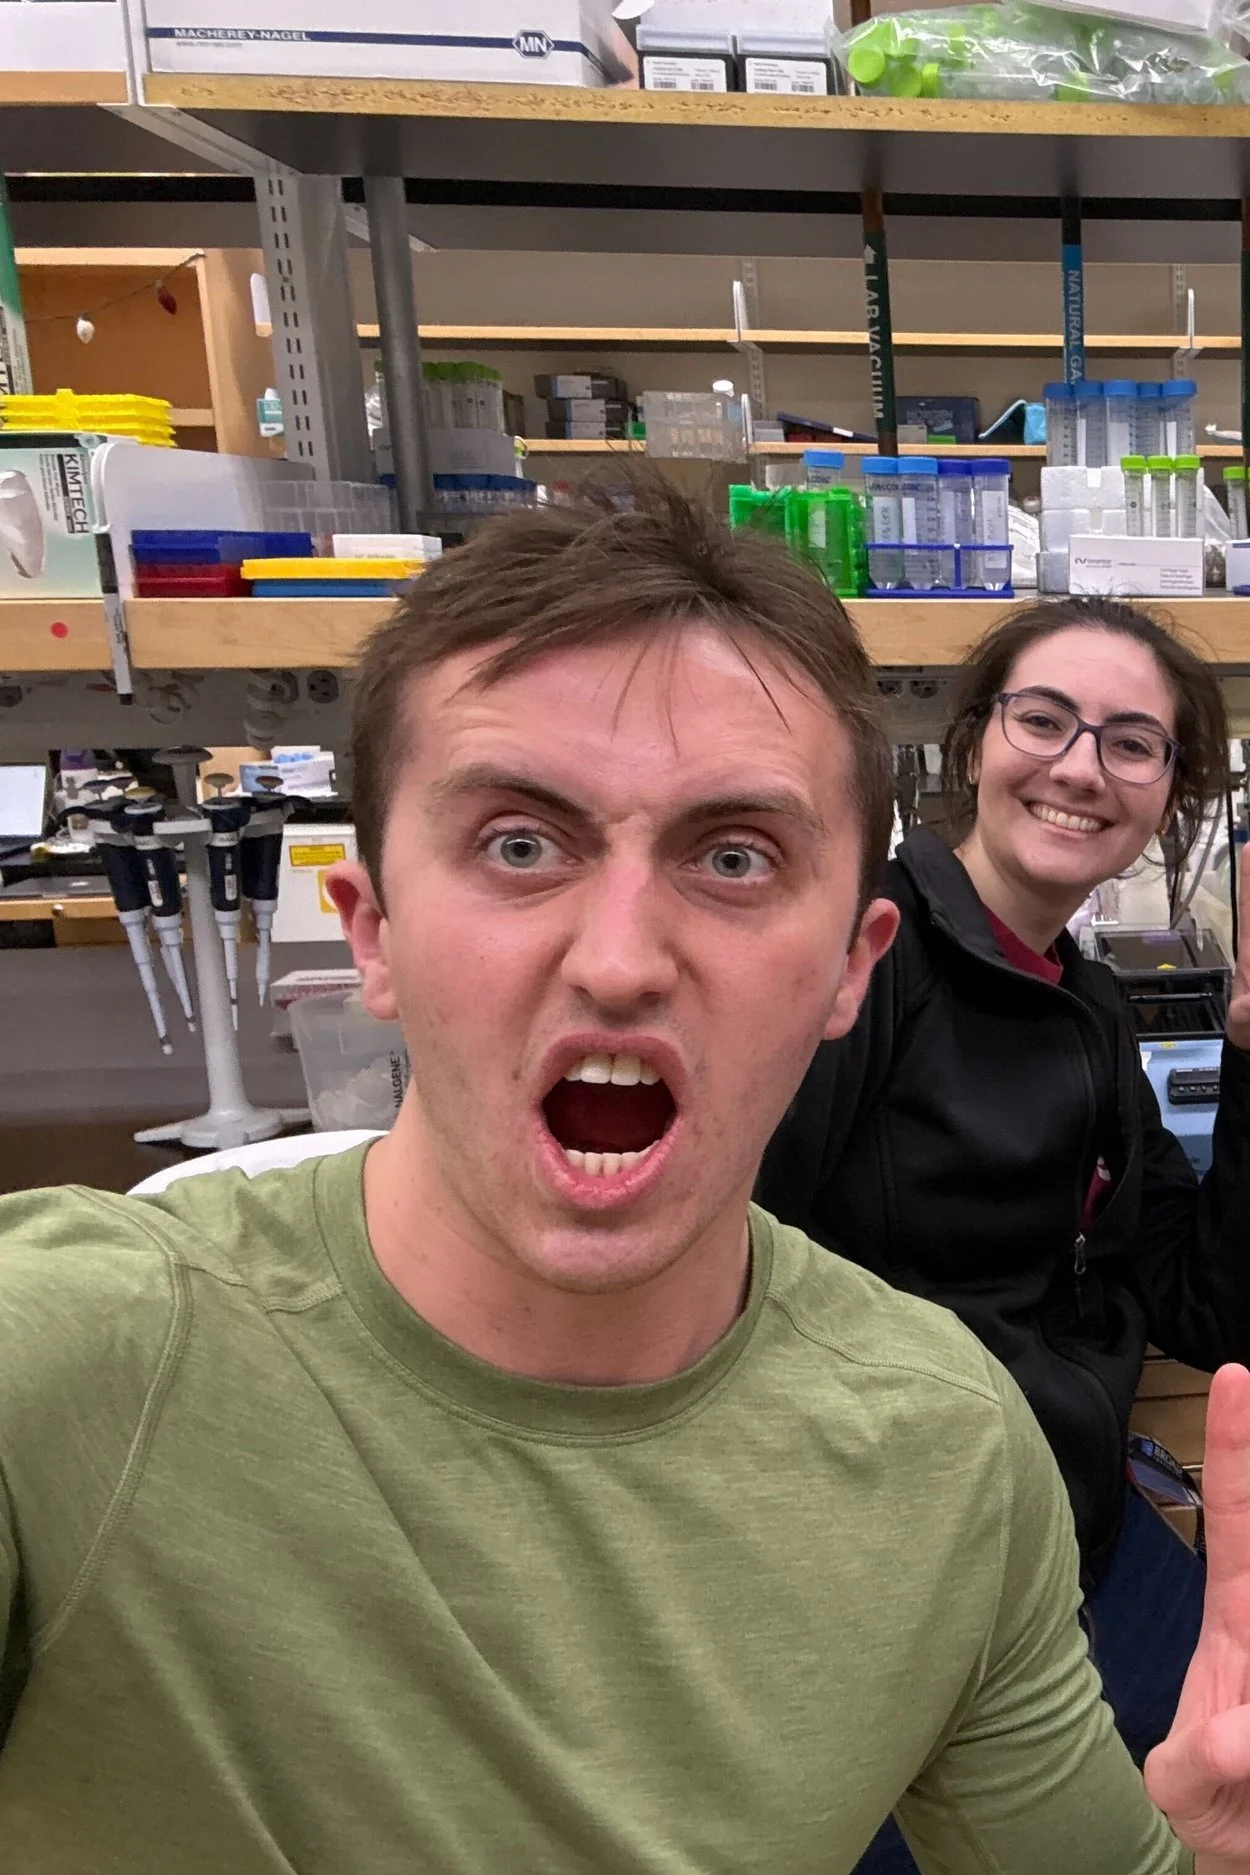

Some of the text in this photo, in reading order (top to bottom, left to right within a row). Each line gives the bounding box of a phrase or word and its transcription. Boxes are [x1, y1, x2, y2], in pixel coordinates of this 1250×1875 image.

[174, 28, 311, 41] MACHEREY-NAGEL
[520, 35, 548, 53] MN
[1068, 269, 1081, 349] NATURAL
[64, 454, 90, 533] KIMTECH
